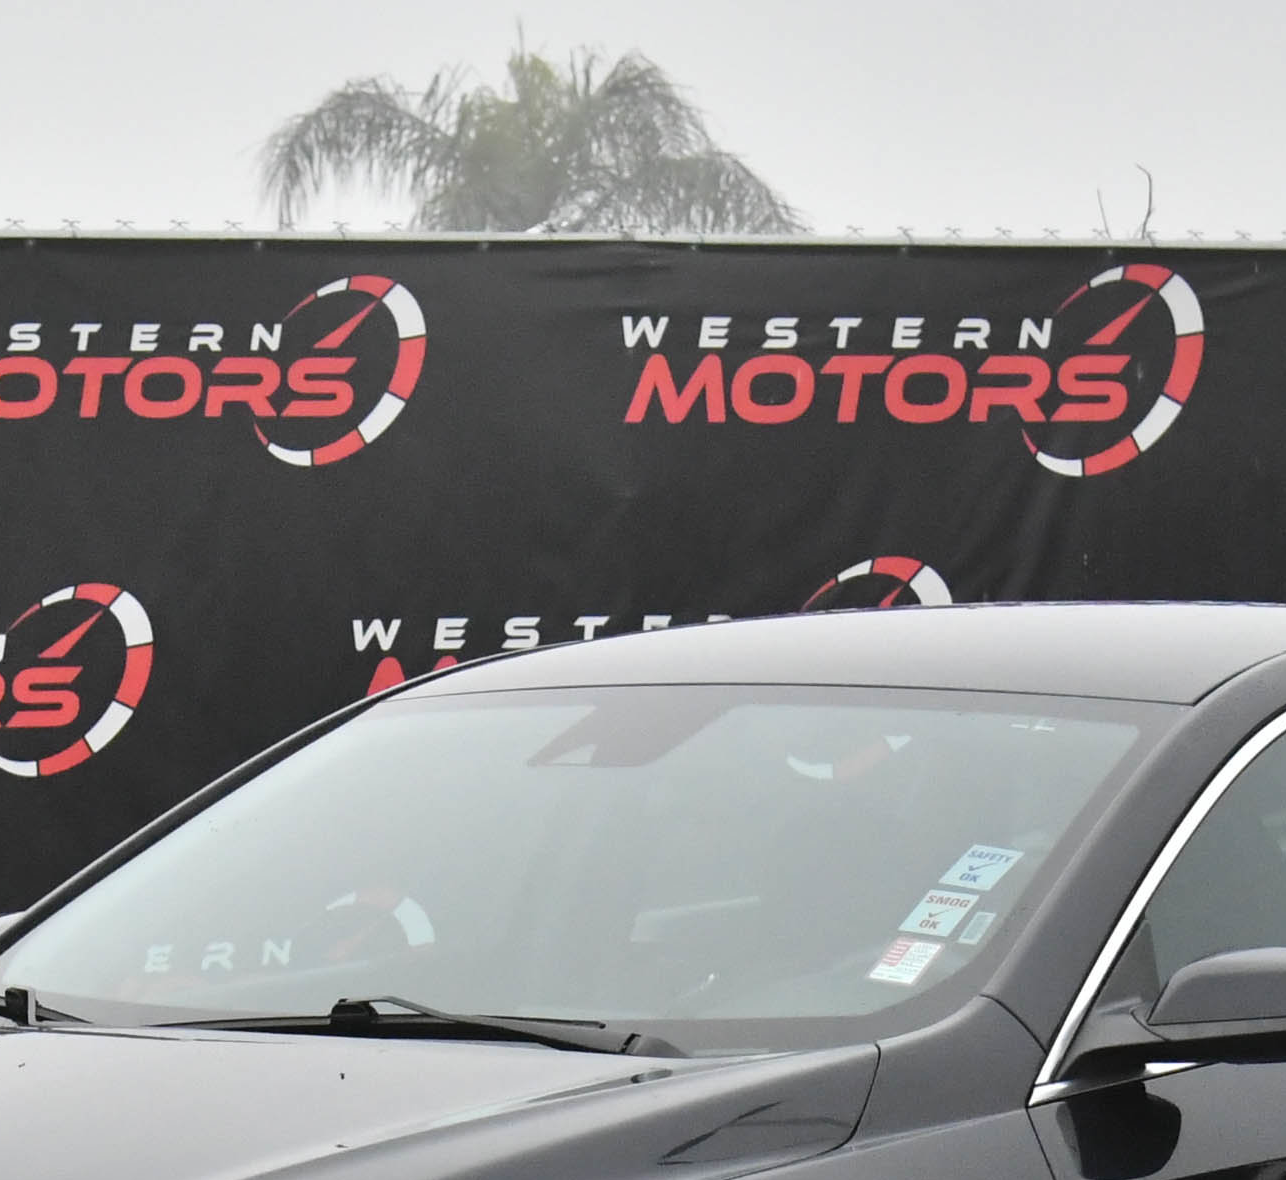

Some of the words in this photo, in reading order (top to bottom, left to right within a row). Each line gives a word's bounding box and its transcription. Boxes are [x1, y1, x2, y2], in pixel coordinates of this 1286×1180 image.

[622, 315, 1053, 349] WESTERN
[624, 354, 1131, 425] MOTORS
[967, 849, 1015, 864] SAFETY
[959, 872, 981, 883] OK
[925, 894, 971, 909] SMOG
[919, 919, 941, 930] OK
